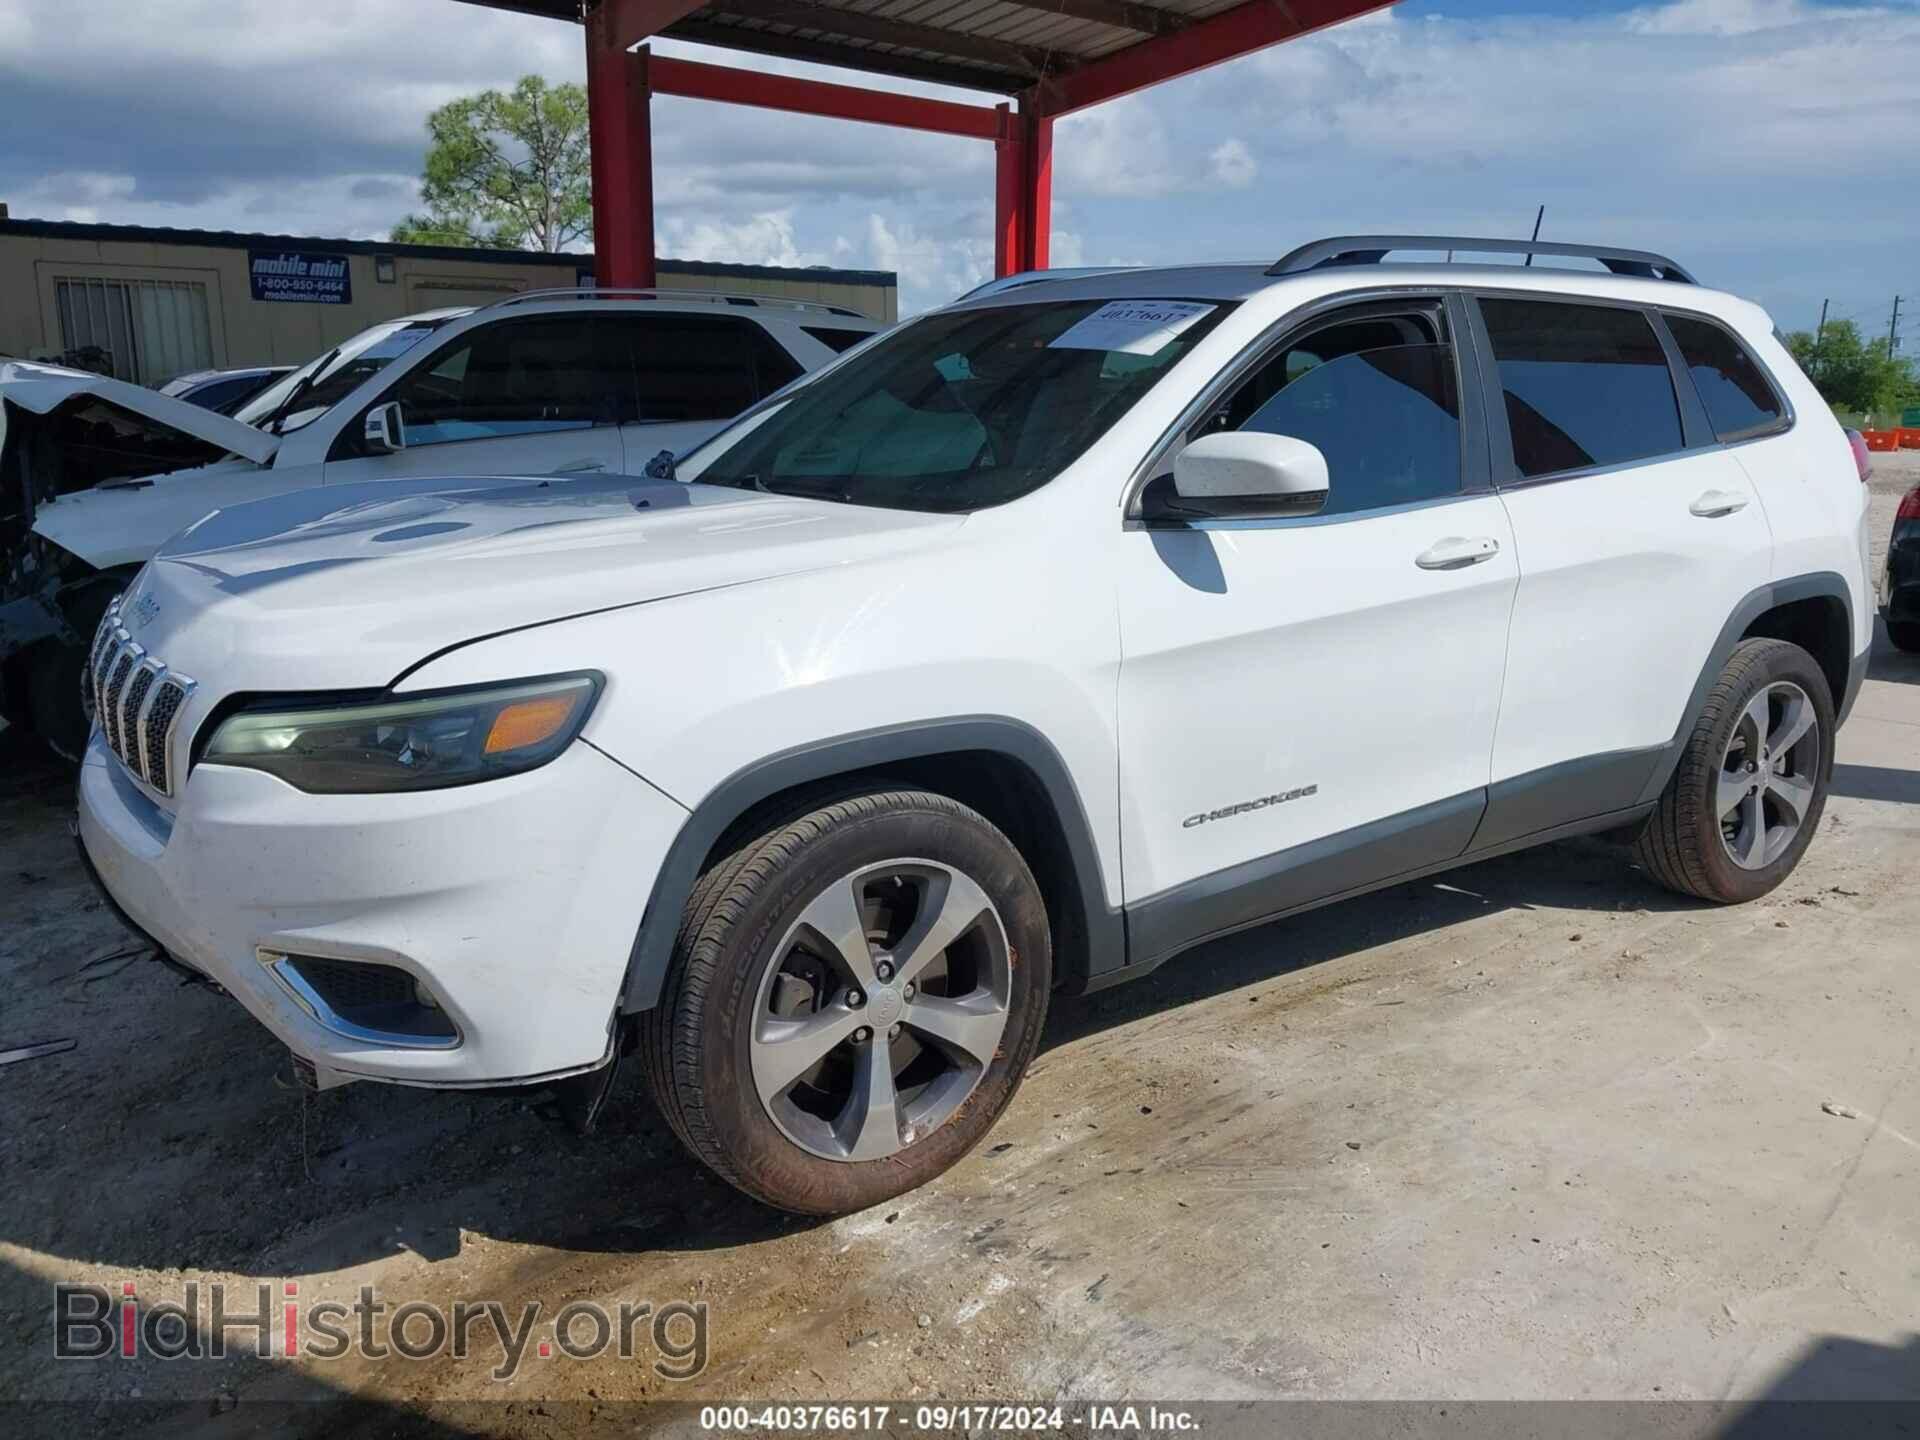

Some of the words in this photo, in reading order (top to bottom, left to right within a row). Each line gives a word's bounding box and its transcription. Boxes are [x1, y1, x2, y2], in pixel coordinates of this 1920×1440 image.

[253, 254, 307, 275] mobile
[309, 260, 346, 277] mini
[264, 291, 341, 303] mobilemini.com
[1183, 784, 1317, 828] CHEROKEE
